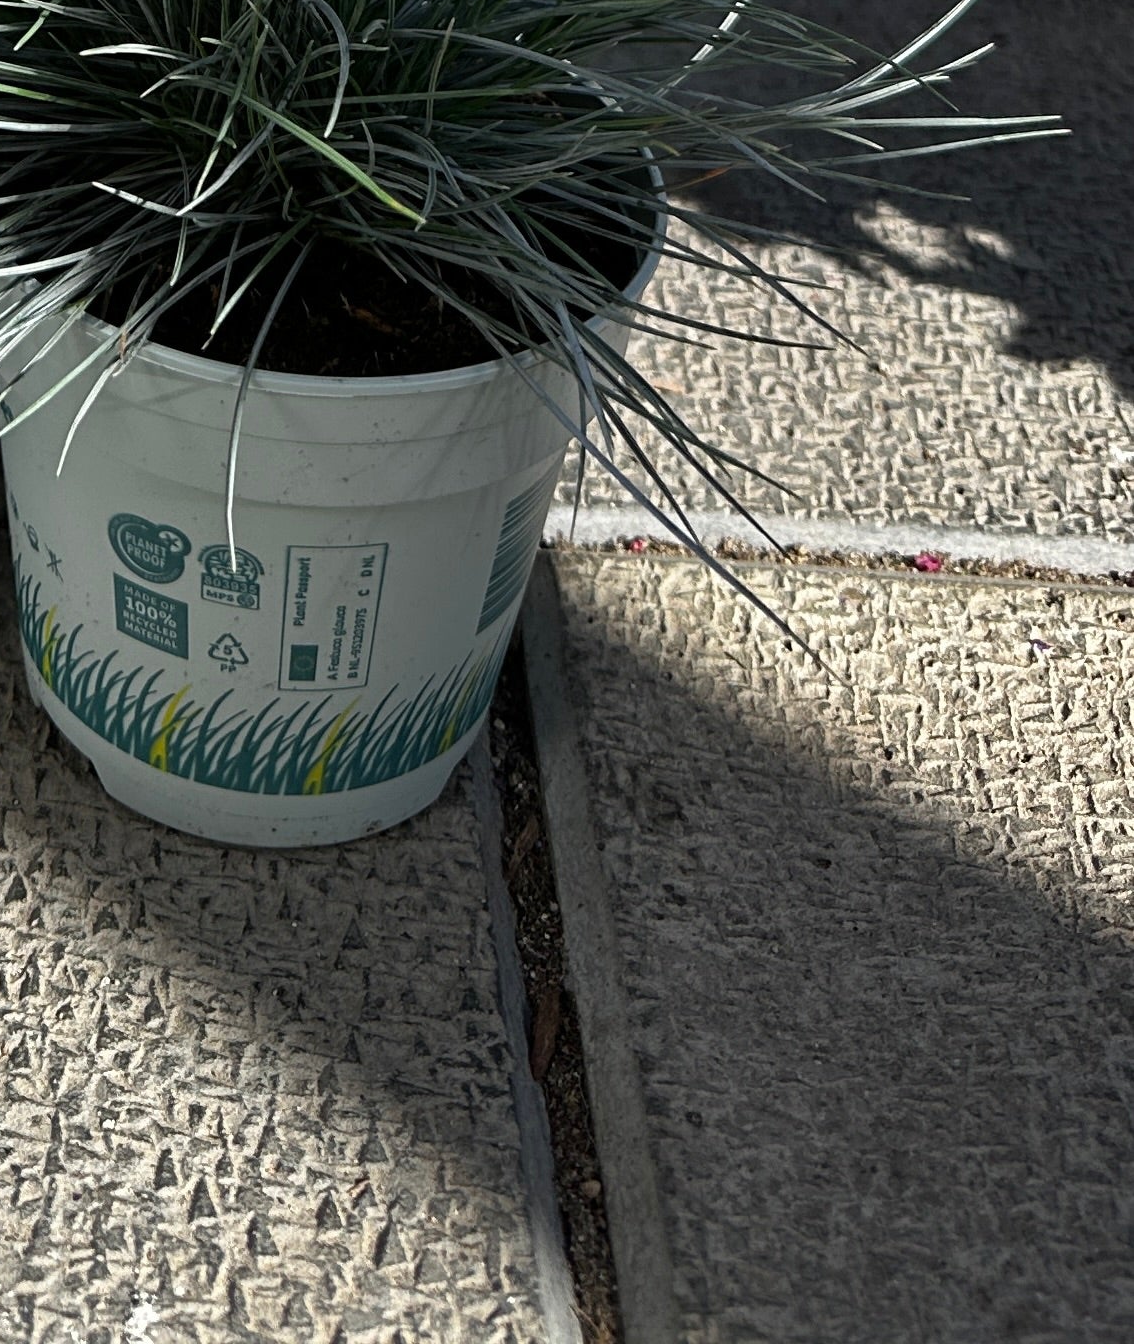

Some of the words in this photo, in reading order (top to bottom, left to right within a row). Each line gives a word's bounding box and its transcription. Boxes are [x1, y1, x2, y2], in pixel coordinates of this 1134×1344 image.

[125, 531, 166, 557] PLANET
[126, 544, 166, 568] PROOF
[362, 554, 376, 568] NL
[295, 557, 313, 599] Passport
[360, 569, 373, 578] D
[124, 584, 157, 605] MADE
[161, 599, 177, 612] OF
[206, 589, 235, 602] MPS
[358, 589, 370, 597] C
[122, 610, 178, 638] RECYCLED
[125, 596, 177, 628] 100%
[293, 601, 307, 626] Plant
[332, 605, 347, 636] glauca
[124, 621, 178, 649] MATERIAL
[223, 645, 233, 656] 5
[328, 638, 342, 672] Festuca
[220, 664, 237, 673] PP
[327, 672, 338, 680] A
[347, 671, 358, 679] B
